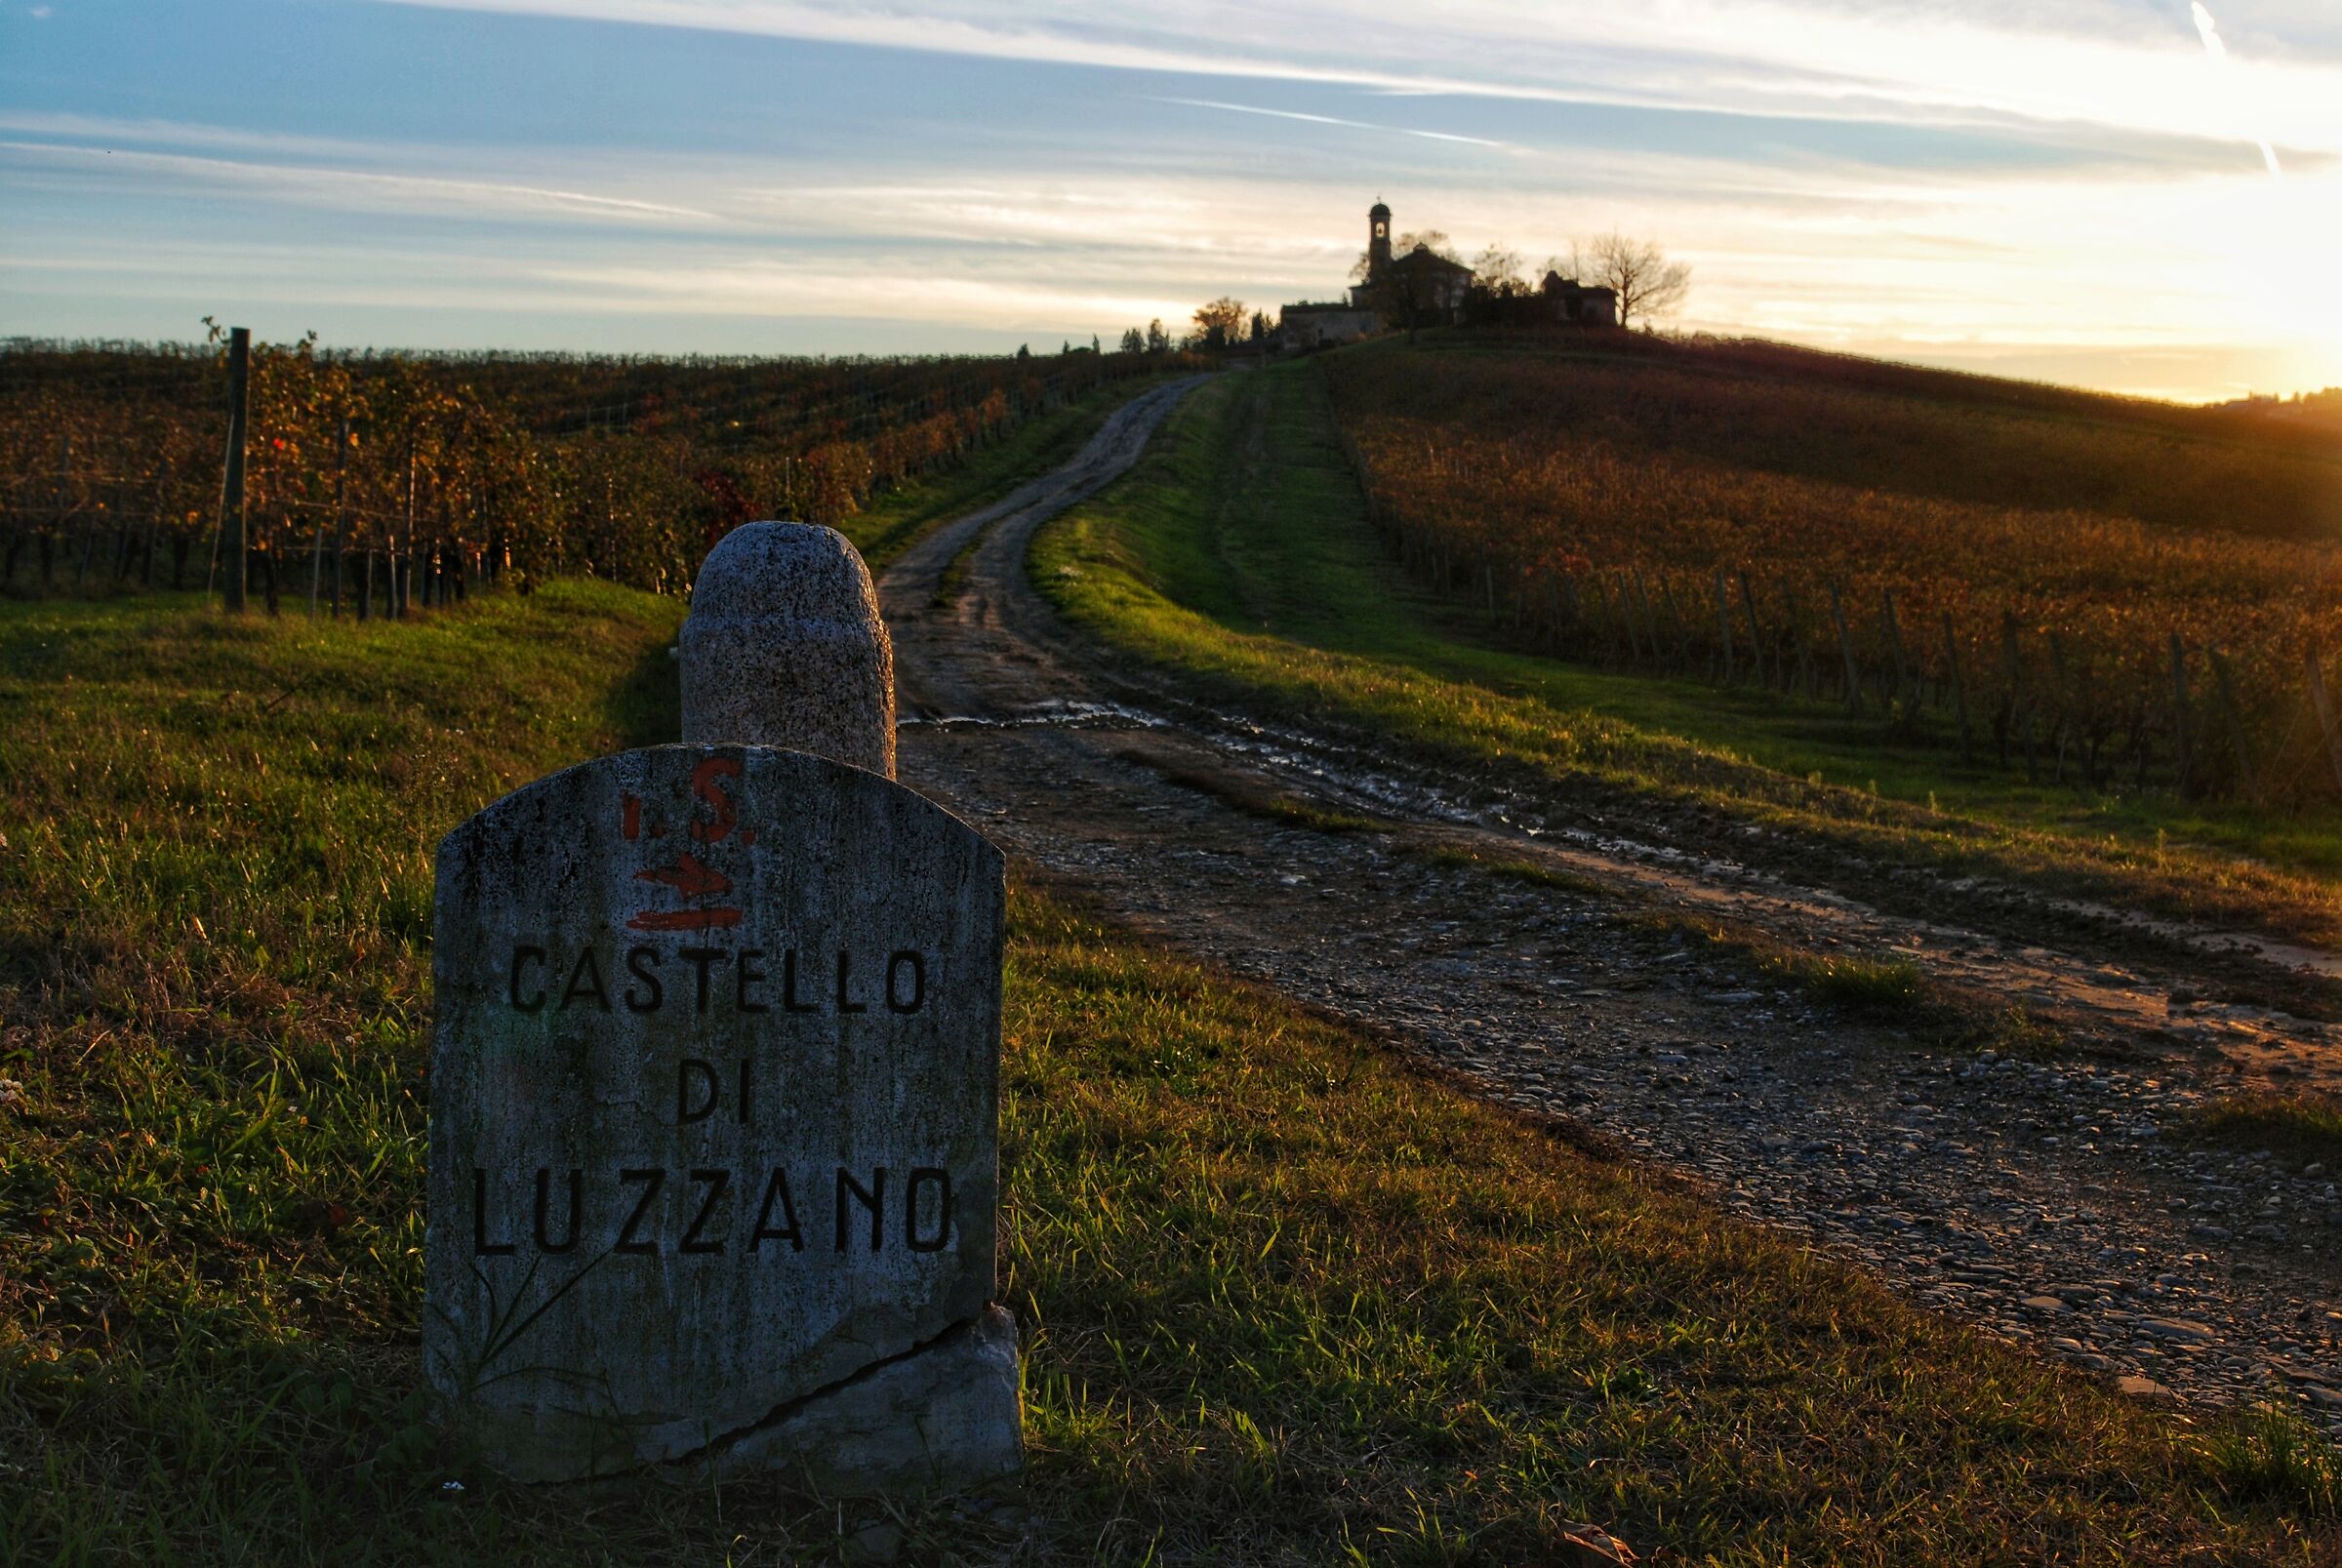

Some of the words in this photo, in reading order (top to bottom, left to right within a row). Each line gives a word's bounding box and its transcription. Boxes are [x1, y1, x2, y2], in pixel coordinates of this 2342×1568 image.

[509, 945, 926, 1015] CASTELLO
[678, 1058, 751, 1124] DI
[473, 1167, 953, 1258] LUZZANO
